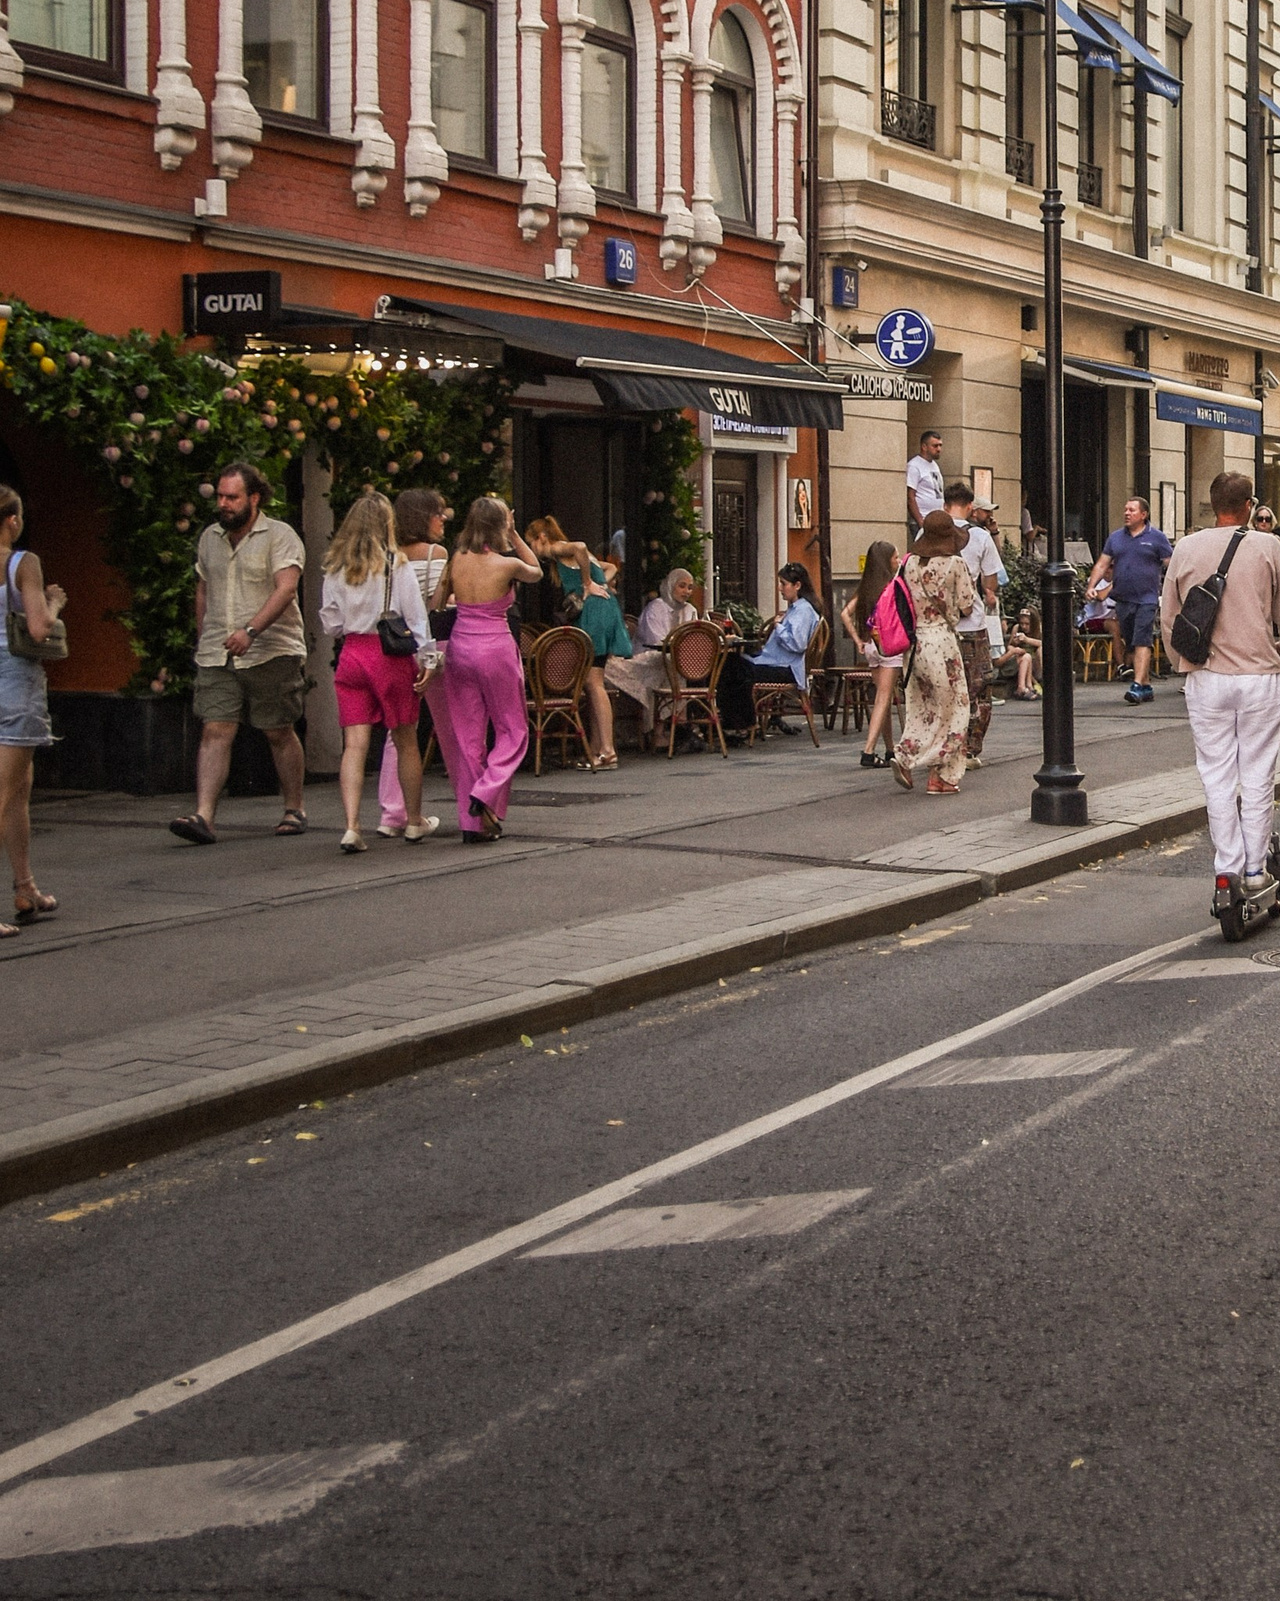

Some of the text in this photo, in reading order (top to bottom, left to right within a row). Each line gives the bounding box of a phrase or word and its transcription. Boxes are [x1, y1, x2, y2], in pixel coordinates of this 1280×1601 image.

[618, 248, 634, 270] 26
[844, 275, 855, 294] 24
[204, 293, 263, 314] GUTAI
[851, 374, 933, 403] САЛОН КРАСОТЫ
[708, 386, 752, 417] GUTAI
